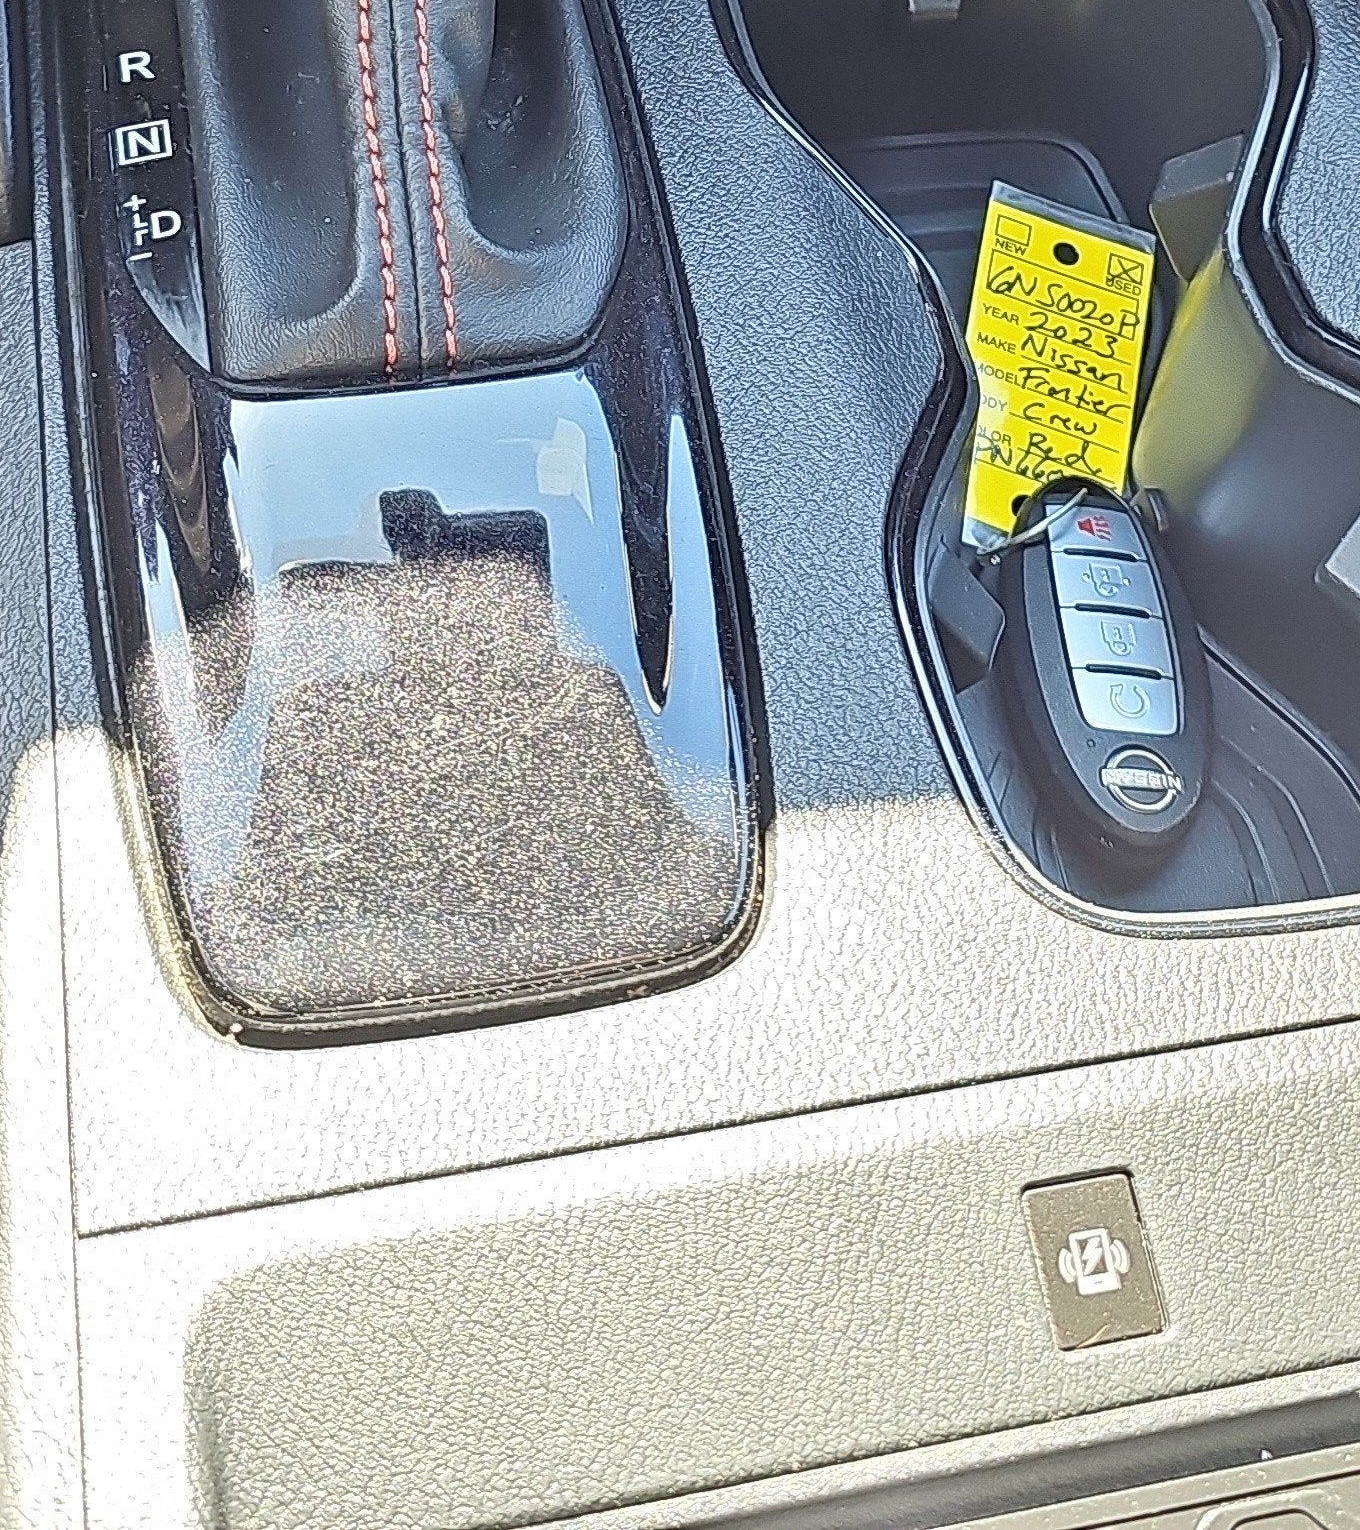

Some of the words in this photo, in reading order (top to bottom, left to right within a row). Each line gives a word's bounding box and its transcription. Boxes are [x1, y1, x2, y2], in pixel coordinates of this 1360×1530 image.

[119, 51, 156, 83] R
[995, 238, 1028, 256] NEW
[1105, 276, 1143, 296] USED
[982, 303, 1020, 325] YEAR
[977, 332, 1017, 354] MAKE
[1023, 311, 1119, 358] 2023
[1020, 334, 1124, 391] Nissan
[1022, 402, 1098, 436] Crew
[1028, 431, 1103, 476] Red
